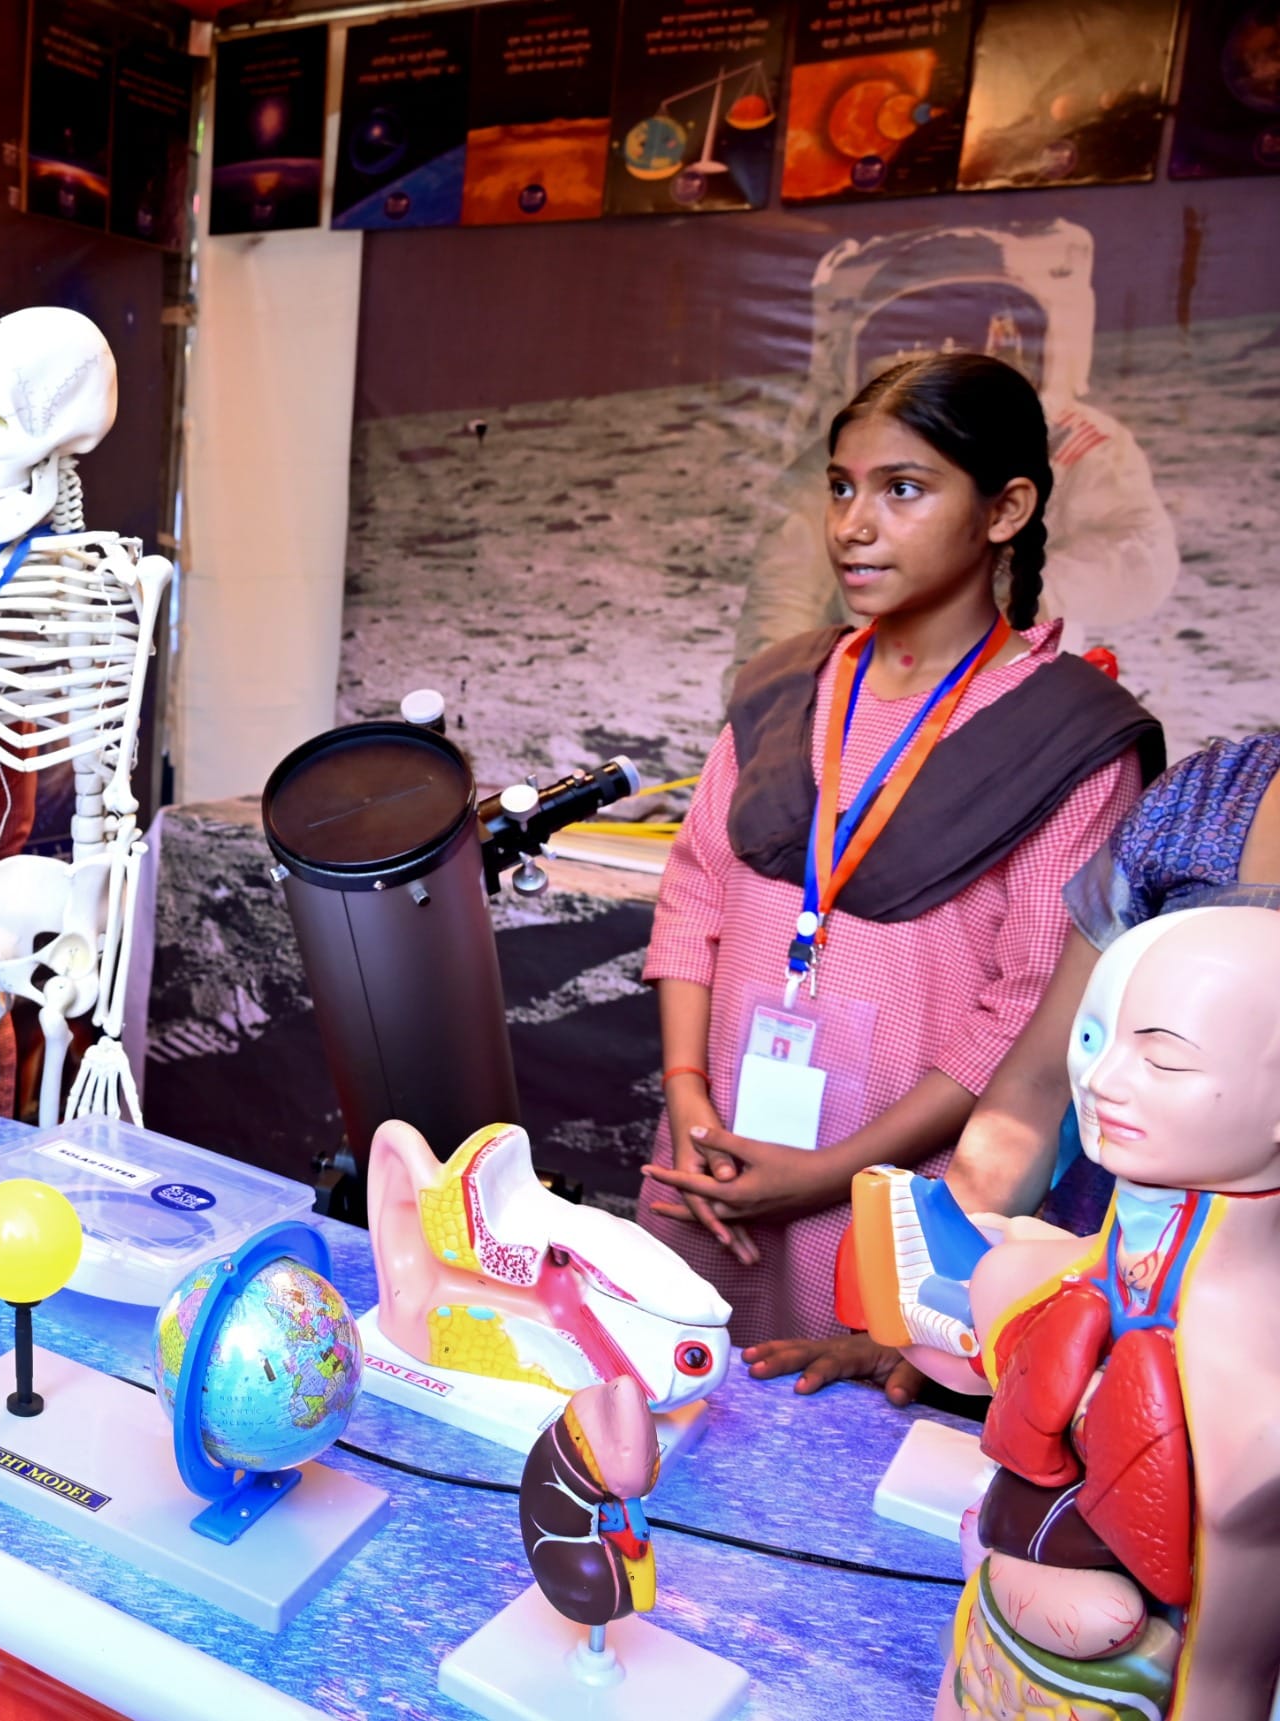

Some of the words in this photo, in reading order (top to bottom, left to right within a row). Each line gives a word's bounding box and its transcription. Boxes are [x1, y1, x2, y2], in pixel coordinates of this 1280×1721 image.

[58, 1149, 98, 1165] SOLAR
[97, 1162, 137, 1179] FILTER
[404, 1372, 448, 1393] EAR
[26, 1466, 96, 1503] MODEL
